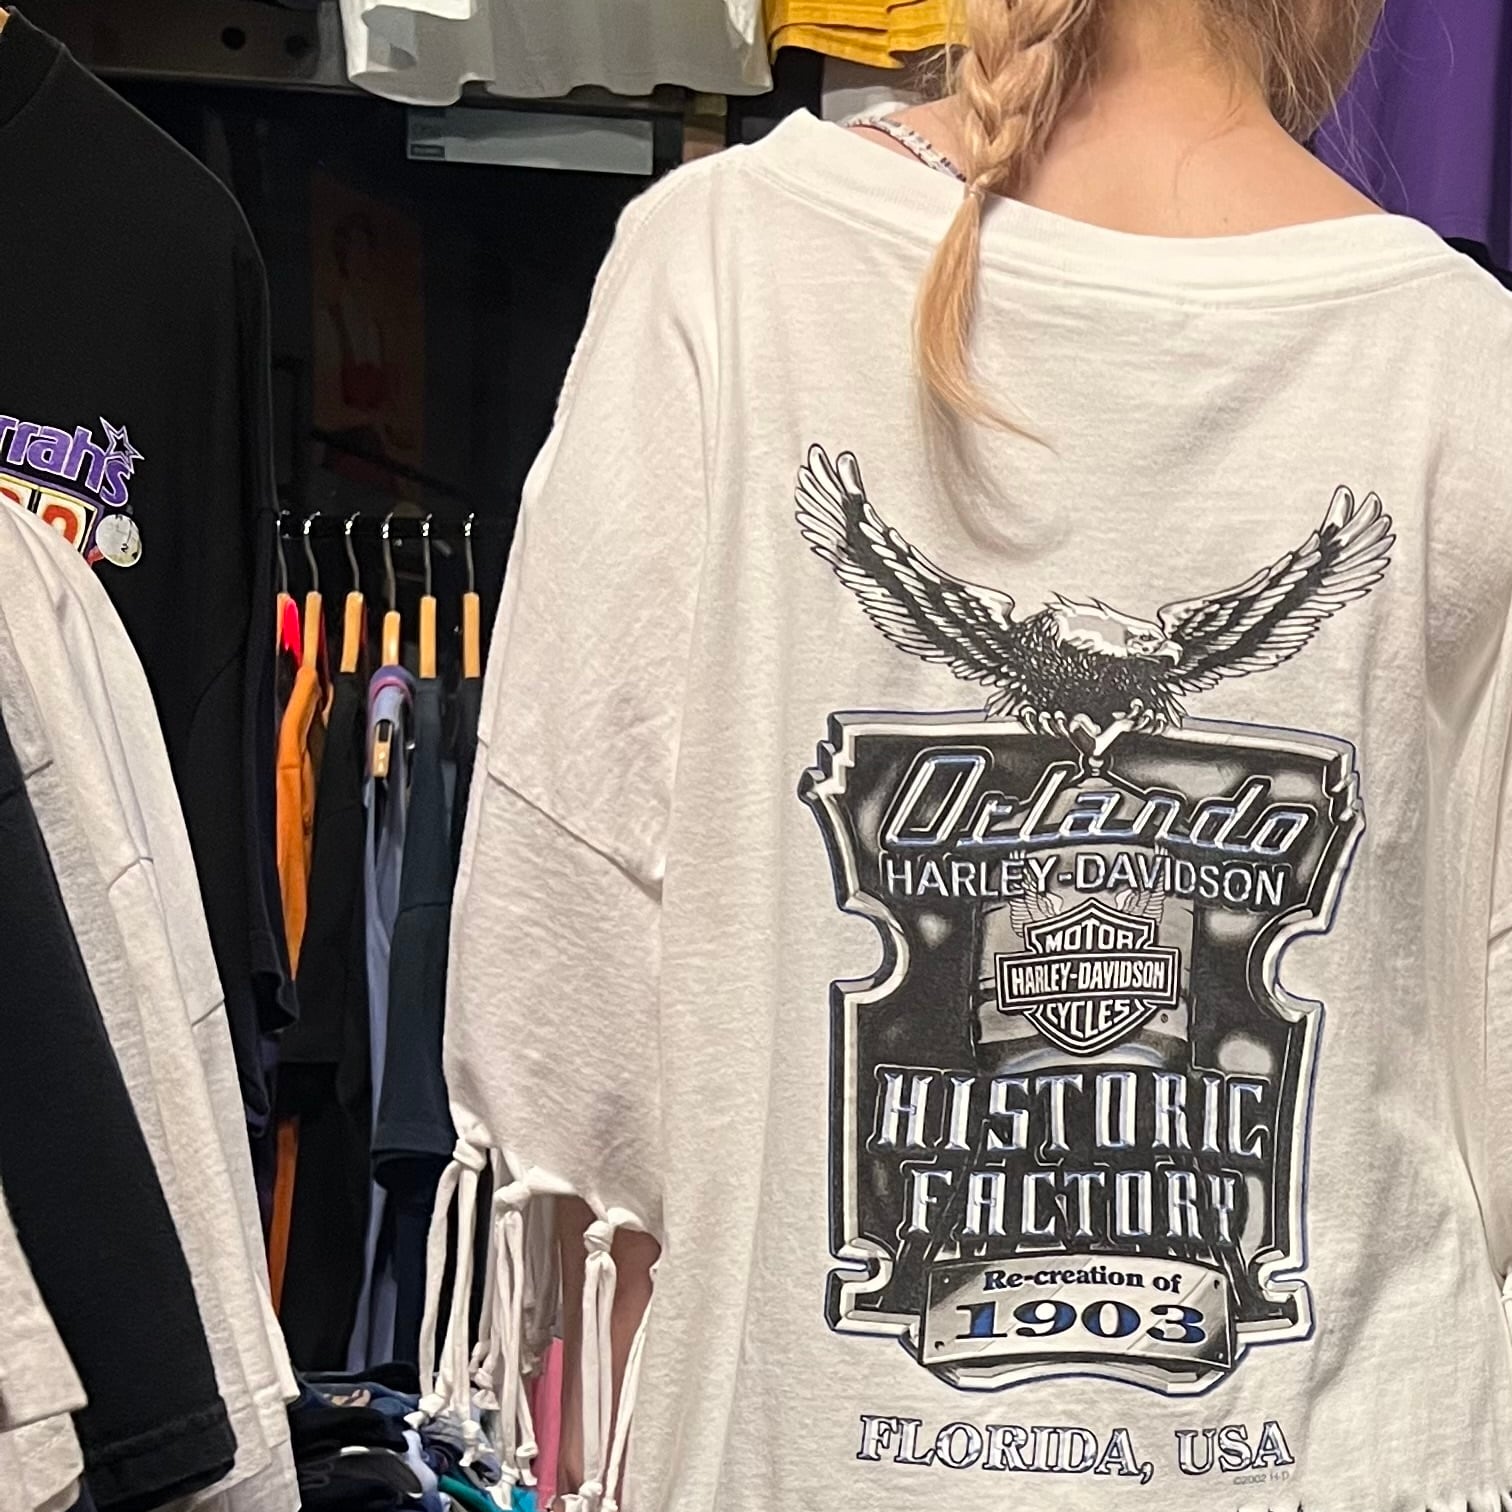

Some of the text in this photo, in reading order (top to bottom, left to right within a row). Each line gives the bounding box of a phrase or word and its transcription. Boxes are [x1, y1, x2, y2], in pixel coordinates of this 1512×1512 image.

[884, 750, 1313, 856] Orlando
[886, 852, 1288, 907] HARLEY-DAVIDSON
[1045, 917, 1134, 953] MOTOR
[1011, 960, 1165, 996] HARLEY-DAVIDSON
[1046, 999, 1130, 1039] CYCLES
[876, 1071, 1270, 1159] HISTORIC
[907, 1169, 1236, 1245] FACTORY
[983, 1265, 1182, 1294] Re-creation of
[956, 1300, 1207, 1345] 1903
[857, 1414, 1296, 1484] FLORIDA, USA
